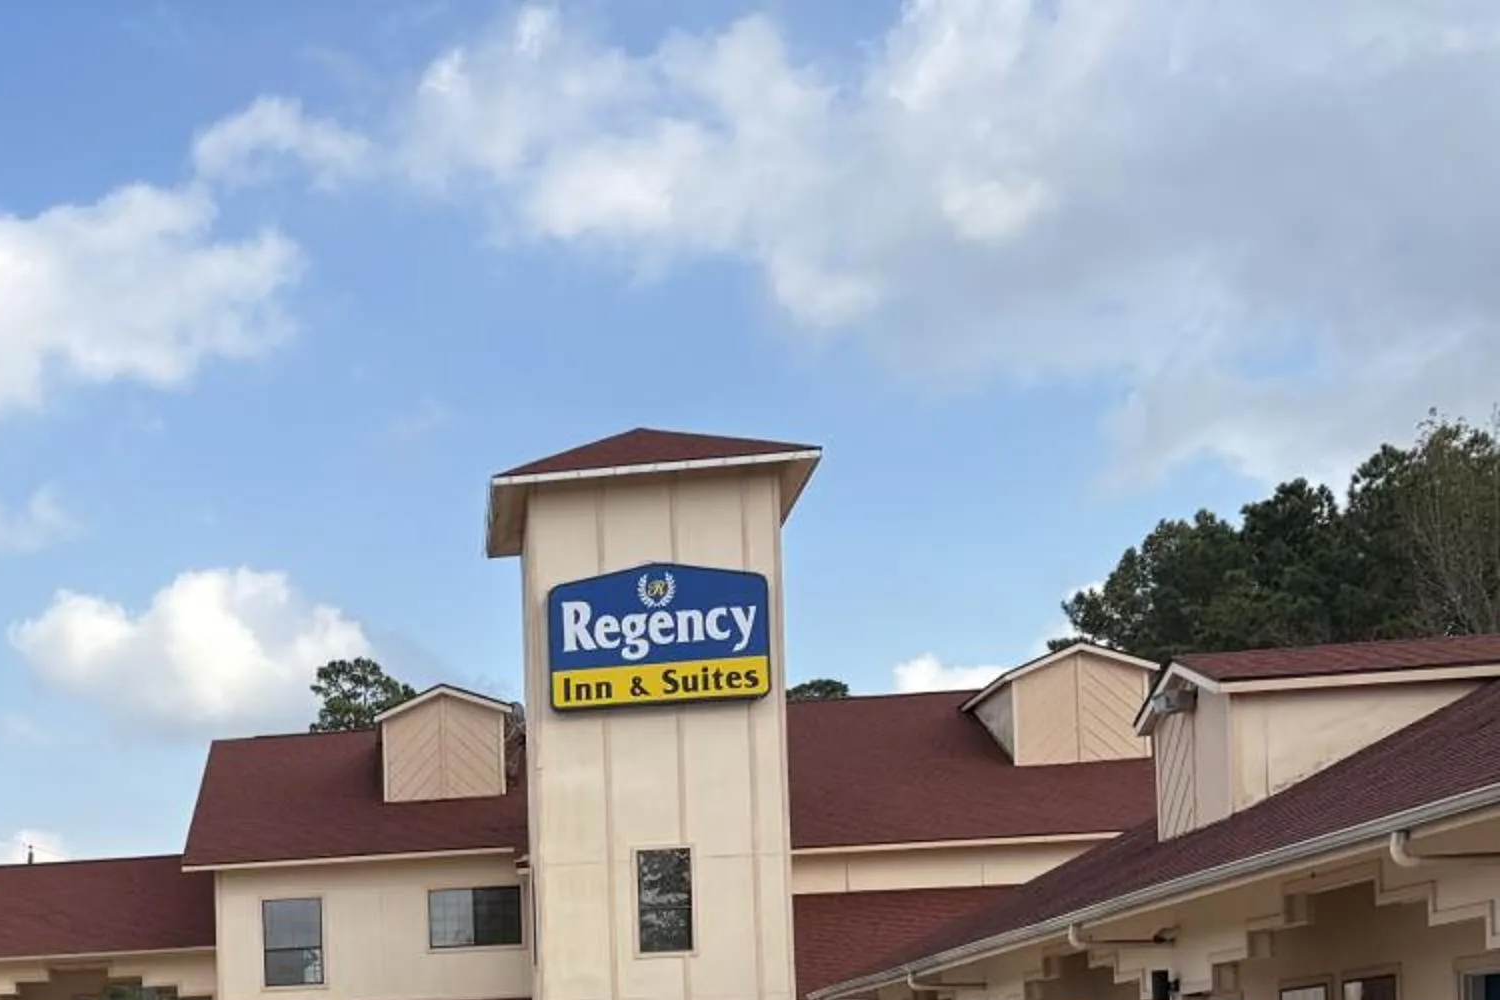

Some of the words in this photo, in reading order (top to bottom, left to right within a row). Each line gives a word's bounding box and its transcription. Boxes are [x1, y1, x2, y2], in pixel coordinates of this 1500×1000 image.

[561, 600, 757, 661] Regency
[562, 677, 613, 703] Inn
[629, 675, 651, 698] &
[661, 666, 760, 695] Suites
